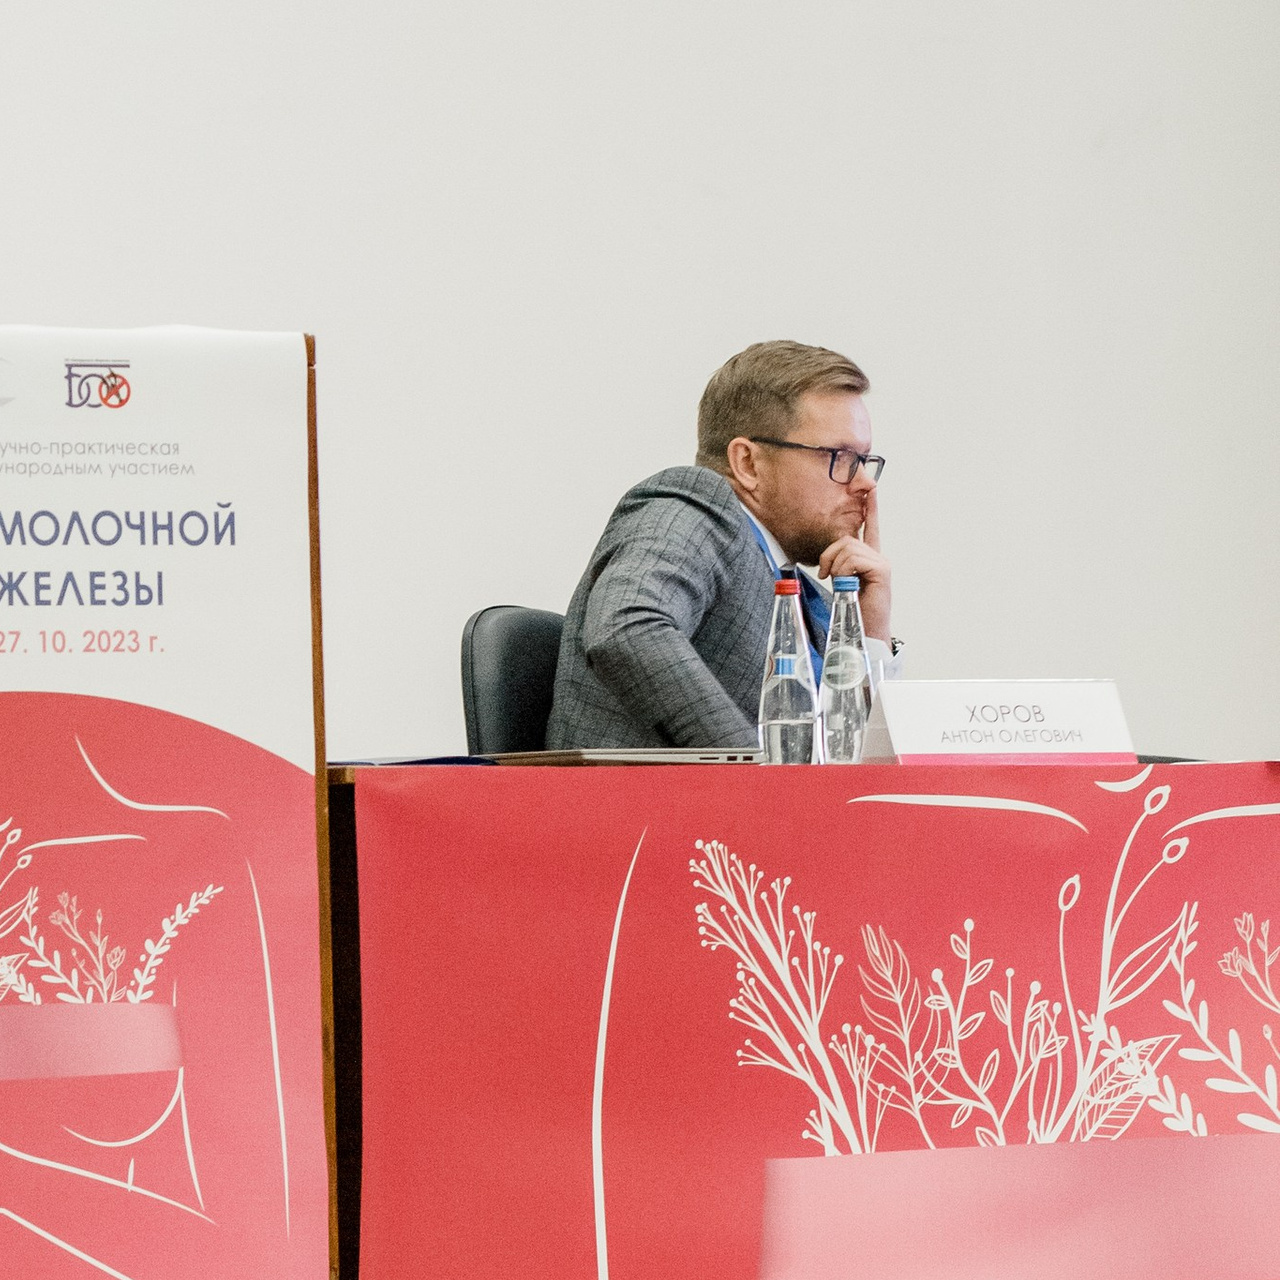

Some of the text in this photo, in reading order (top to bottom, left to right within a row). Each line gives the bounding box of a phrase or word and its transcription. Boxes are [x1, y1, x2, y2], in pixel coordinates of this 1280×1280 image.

[109, 461, 195, 478] участием
[38, 630, 73, 654] 10.
[82, 629, 141, 654] 2023
[149, 635, 165, 653] г.
[965, 704, 1046, 723] ХОРОВ
[940, 728, 1084, 744] АНТОН ОЛЕГОВИЧ
